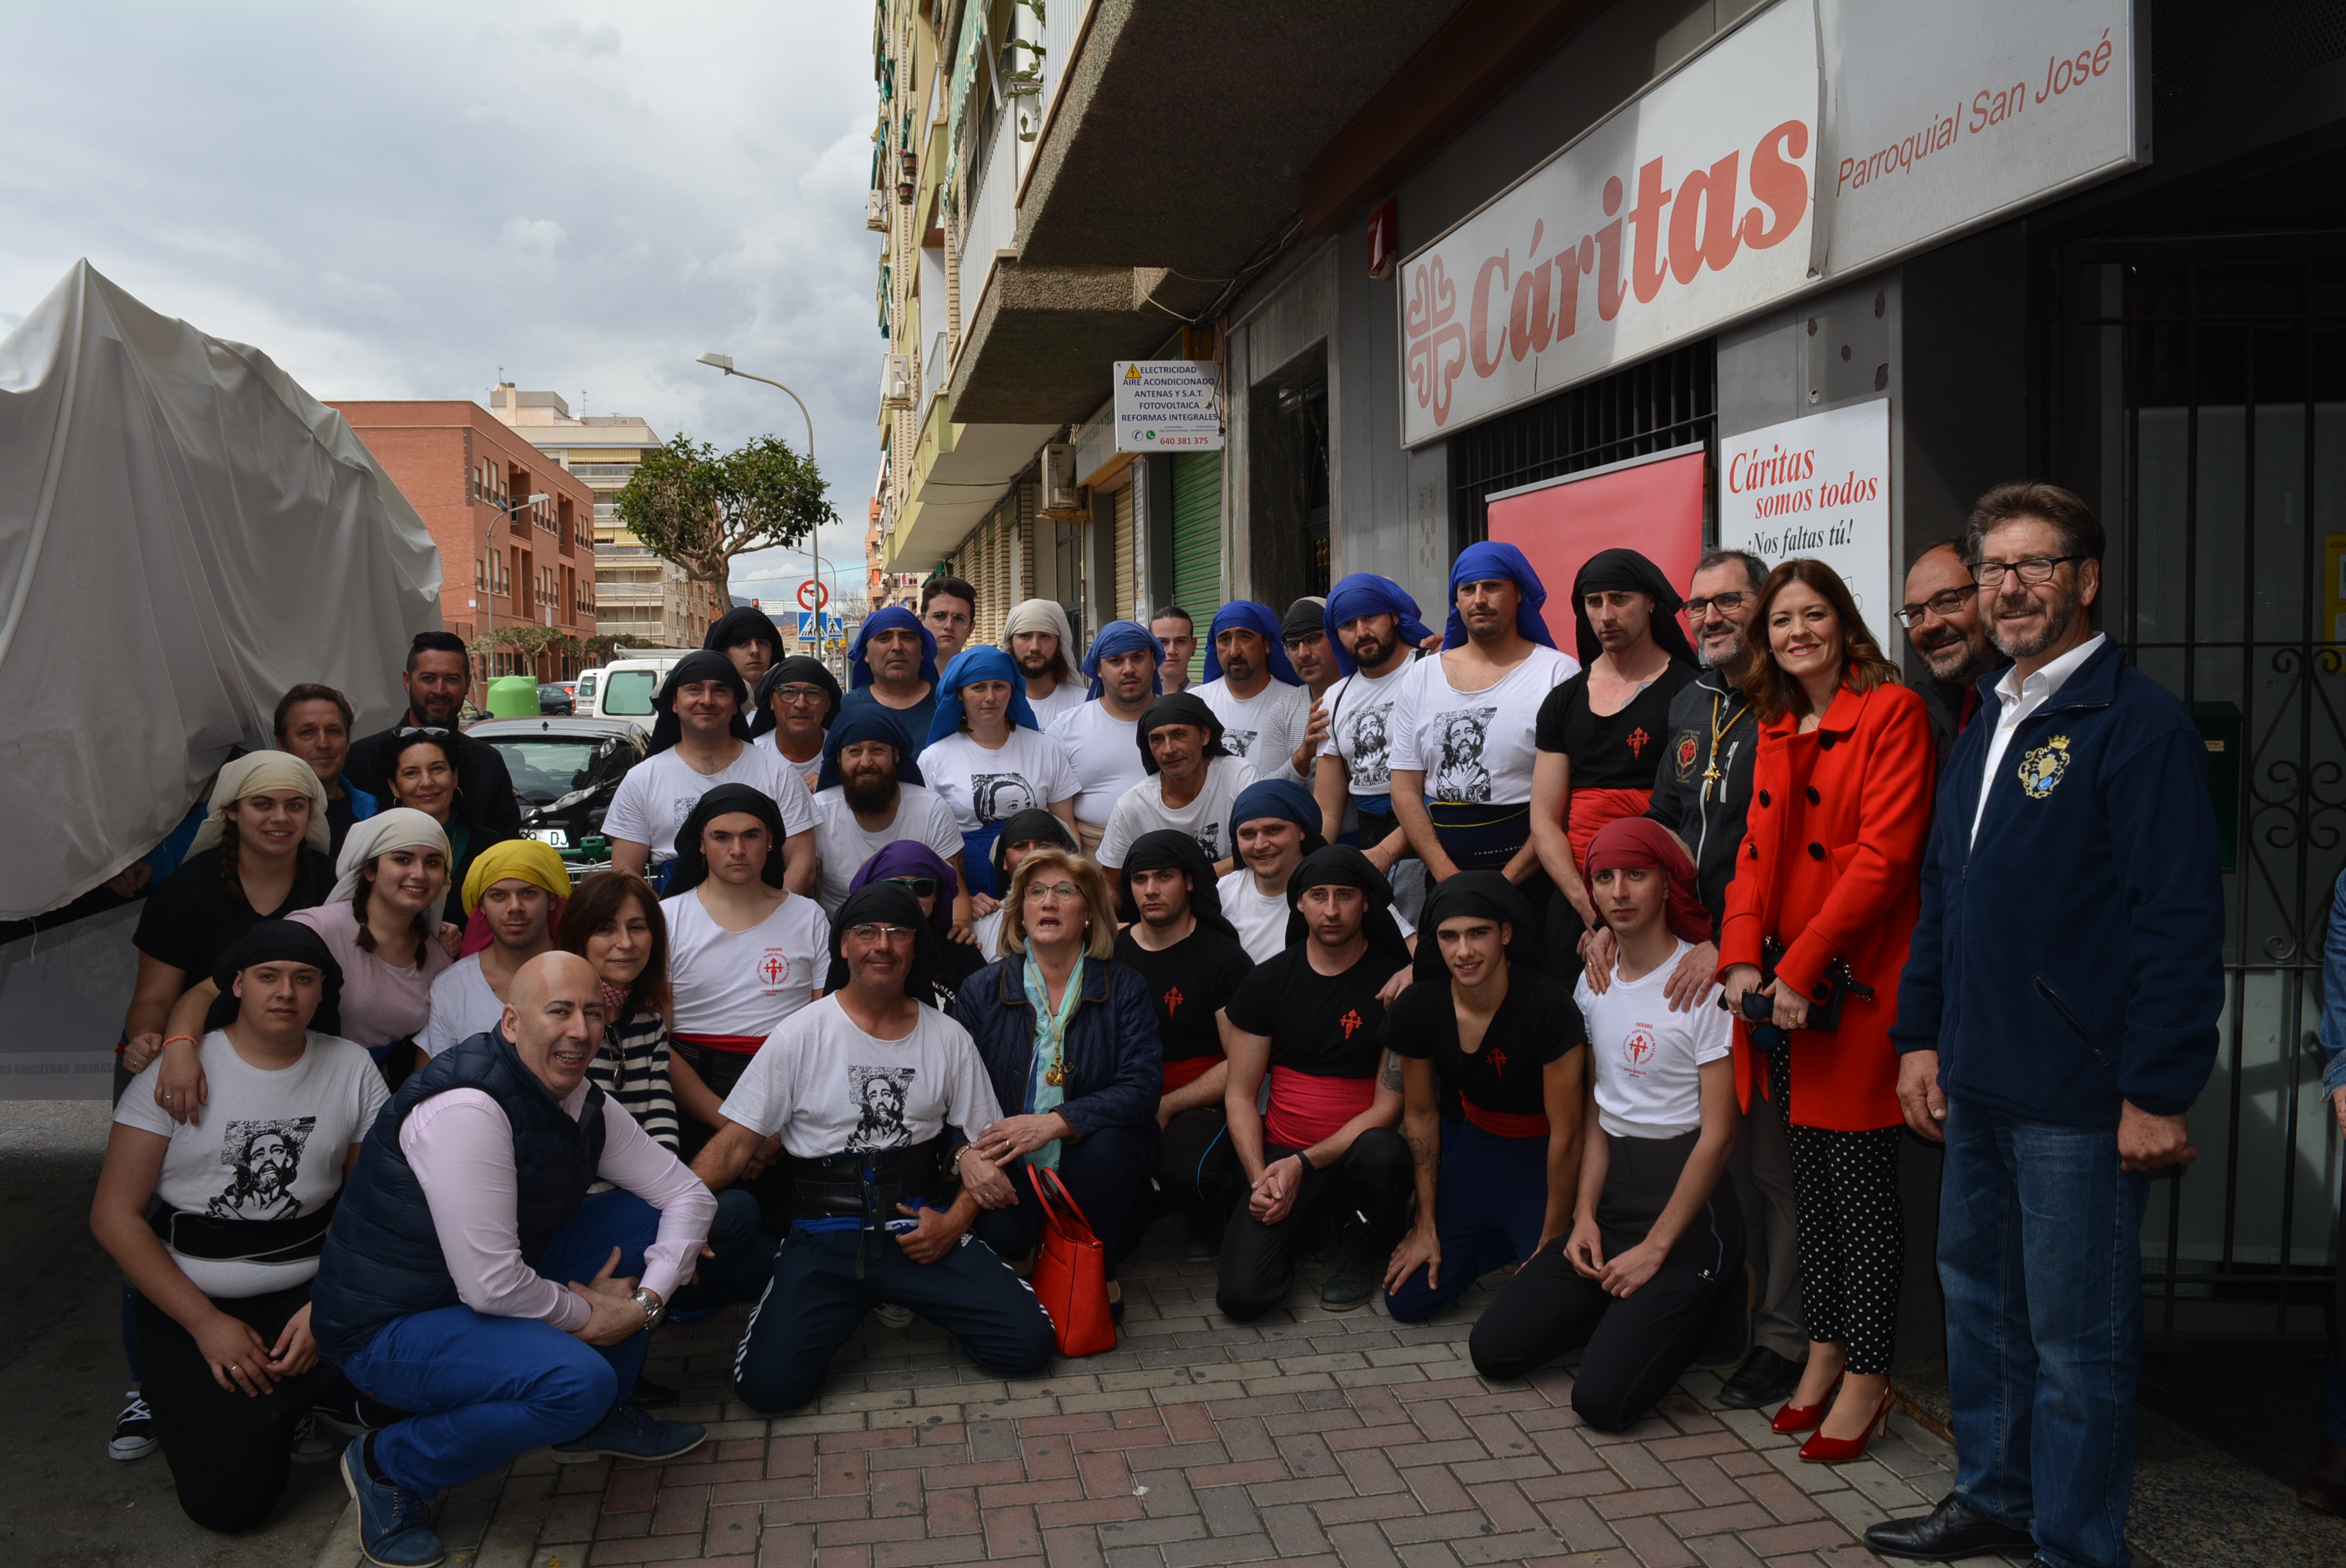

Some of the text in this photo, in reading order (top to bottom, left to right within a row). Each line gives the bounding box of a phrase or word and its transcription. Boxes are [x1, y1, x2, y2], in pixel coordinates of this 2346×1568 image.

[1836, 27, 2112, 198] Parroquial San José
[1470, 119, 1809, 379] Cáritas
[1139, 401, 1200, 410] FOTOVOLTAICA
[1143, 377, 1215, 386] ACONDICIONADO
[1729, 444, 1815, 493] Cáritas
[1755, 470, 1878, 519] somos todos
[1779, 525, 1825, 559] faltas
[1828, 518, 1854, 546] tú!
